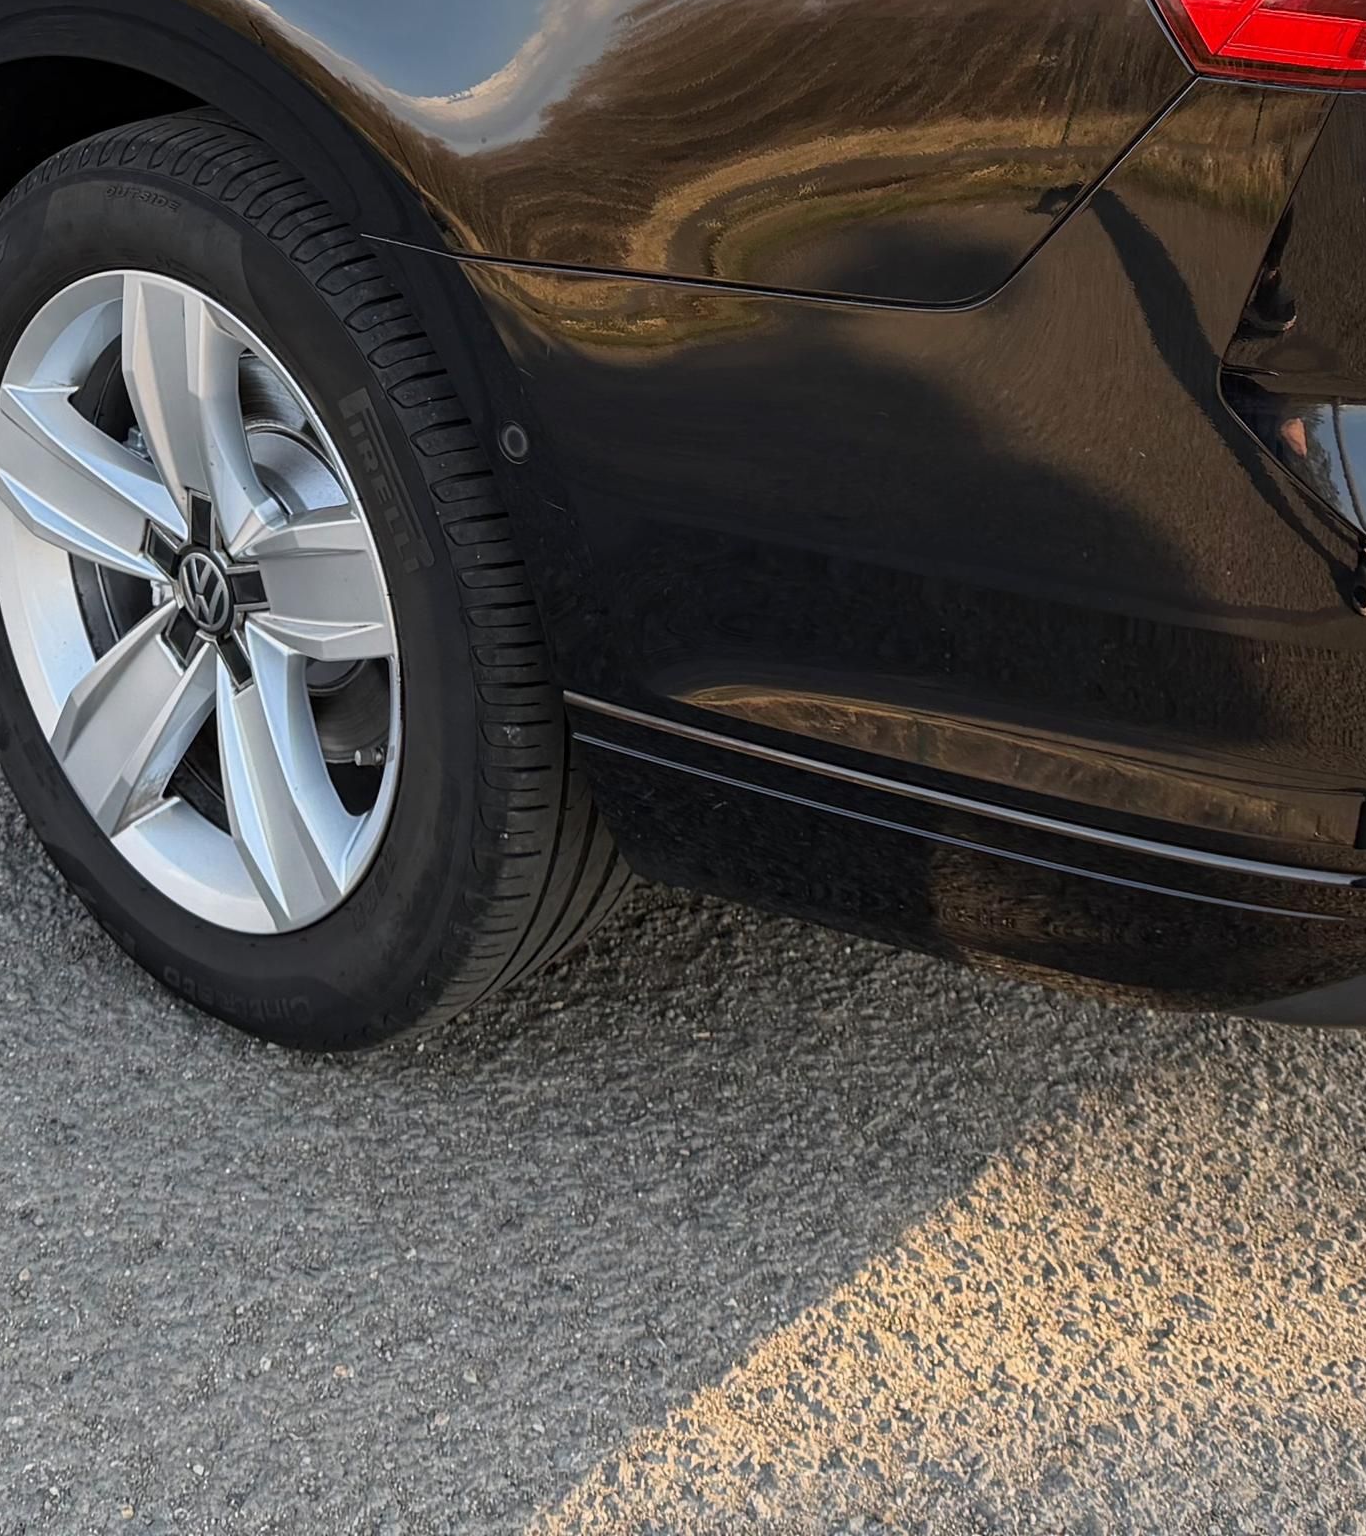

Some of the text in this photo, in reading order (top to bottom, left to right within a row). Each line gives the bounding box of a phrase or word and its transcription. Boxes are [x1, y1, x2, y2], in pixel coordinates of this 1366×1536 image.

[105, 184, 181, 212] OUTSIDE
[338, 386, 435, 573] PIRELLI
[179, 552, 230, 633] VW
